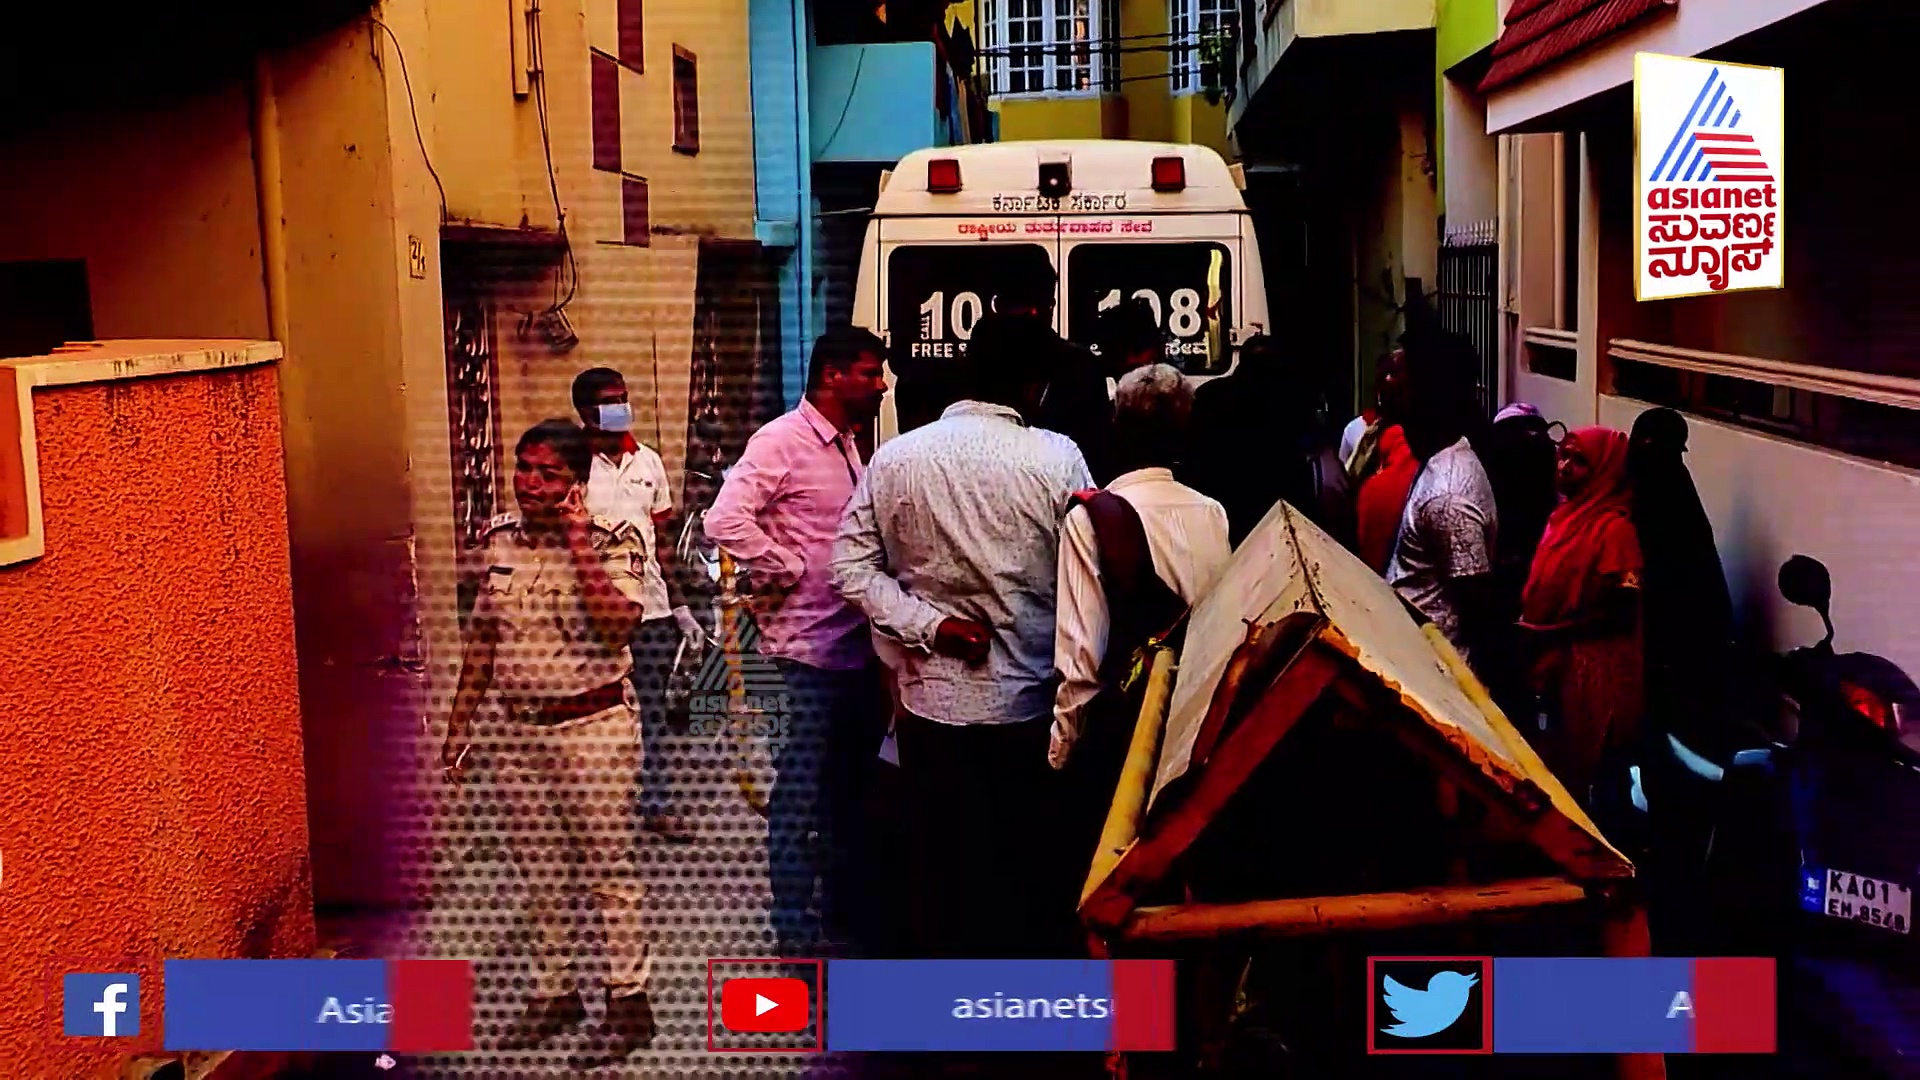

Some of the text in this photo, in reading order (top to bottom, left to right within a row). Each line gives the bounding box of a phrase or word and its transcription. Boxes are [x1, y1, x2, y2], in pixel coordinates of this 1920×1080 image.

[920, 290, 998, 340] 10
[912, 342, 954, 358] FREE
[1830, 871, 1890, 905] KA01
